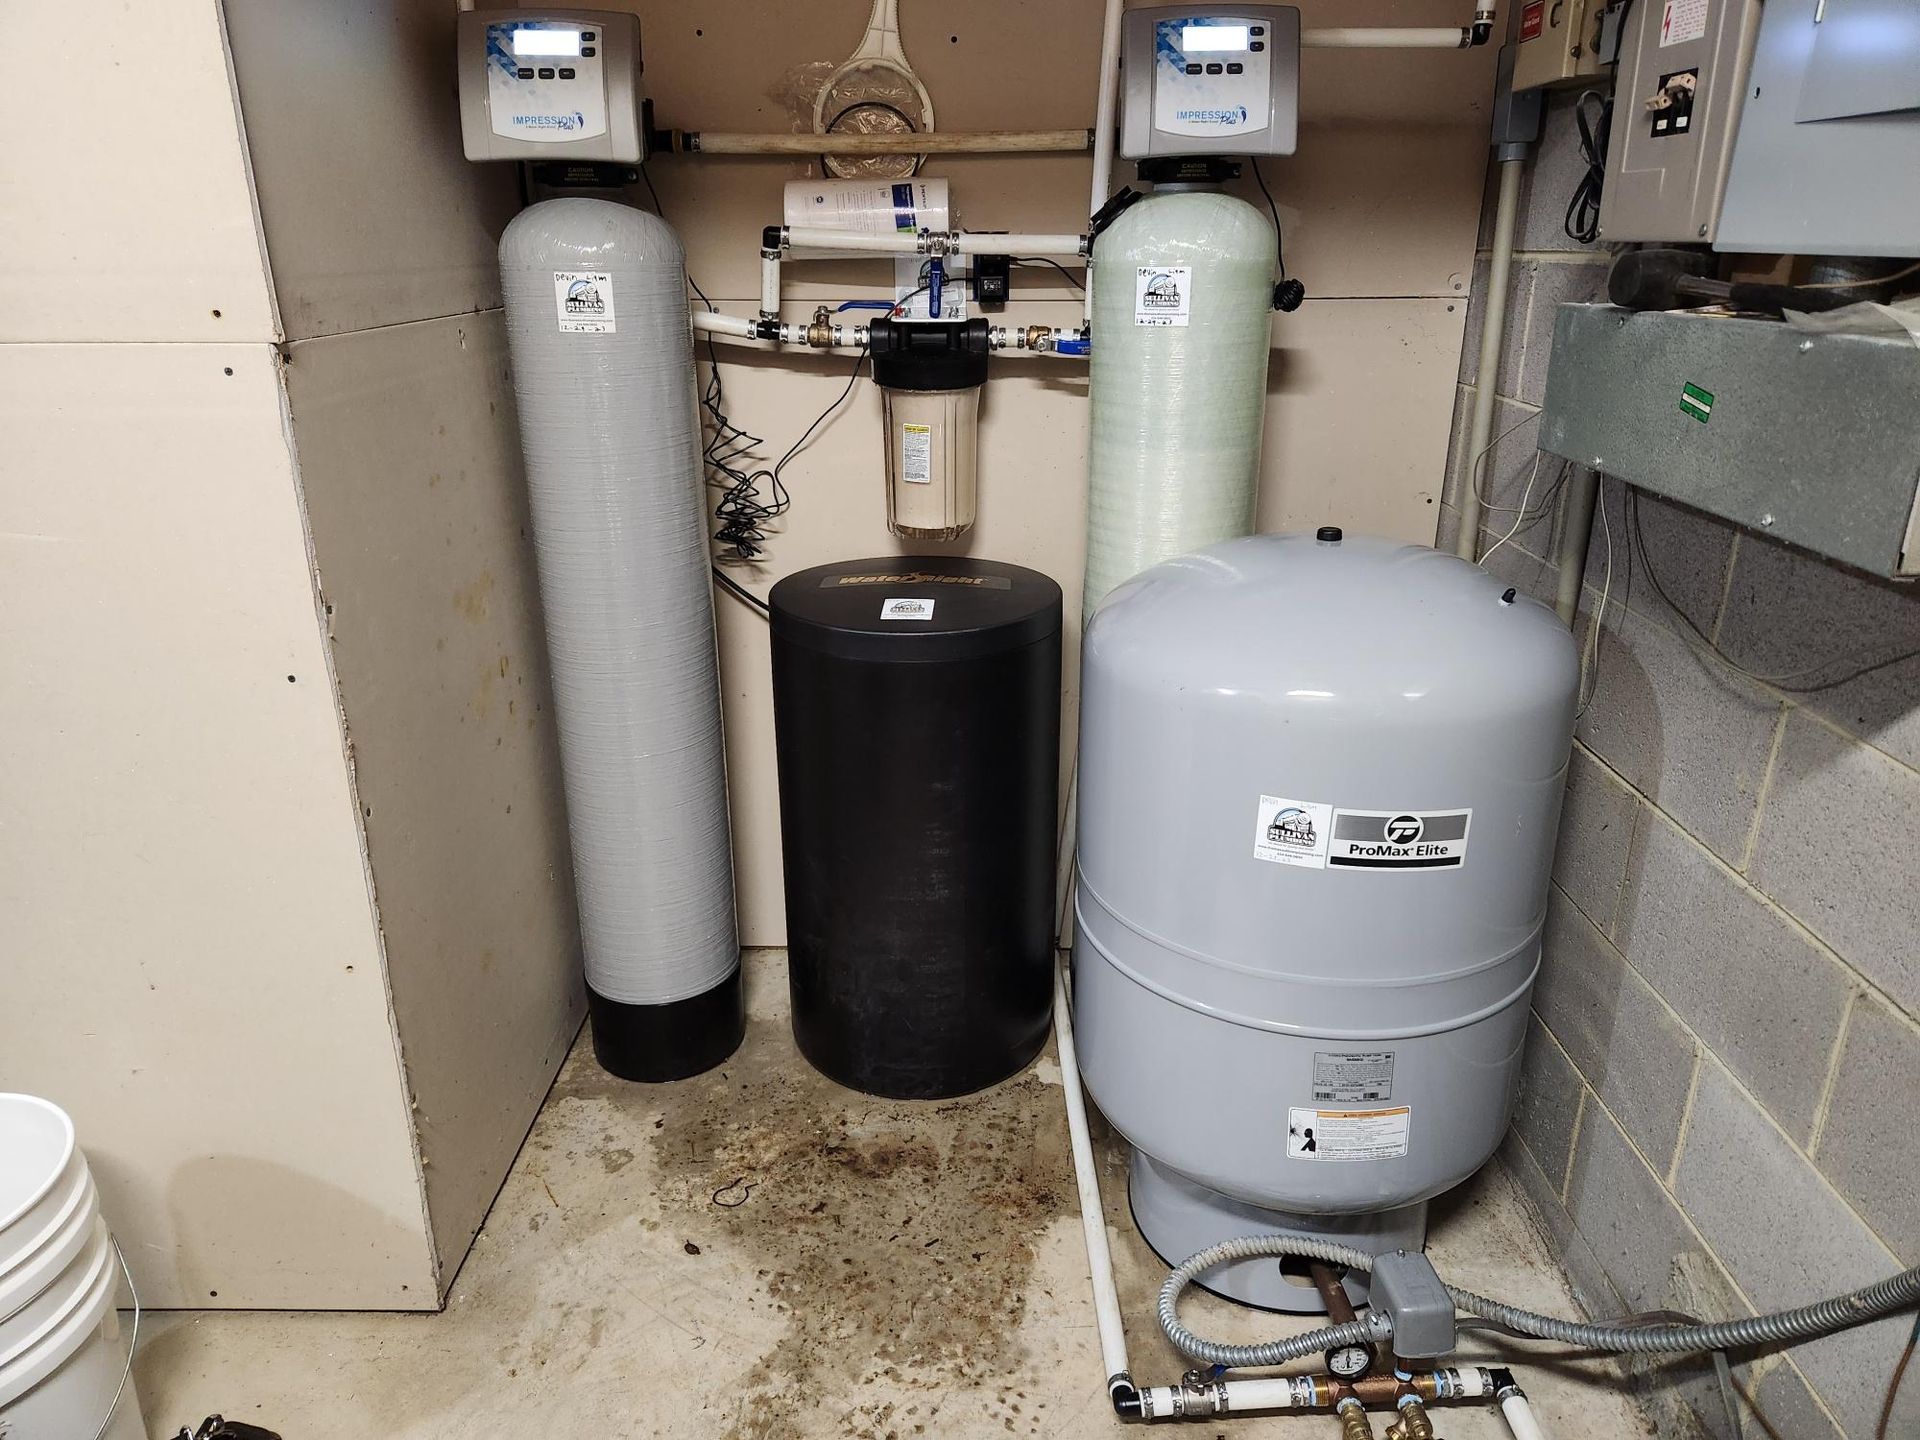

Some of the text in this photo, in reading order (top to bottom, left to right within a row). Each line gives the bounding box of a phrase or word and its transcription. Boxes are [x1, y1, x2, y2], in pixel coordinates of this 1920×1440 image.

[512, 115, 575, 125] IMPRESSION
[1176, 110, 1238, 120] IMPRESSION
[1219, 115, 1237, 125] Plus
[1269, 828, 1315, 841] SULLIVAN
[1268, 834, 1315, 847] PLUMBING
[1416, 844, 1449, 856] Elite
